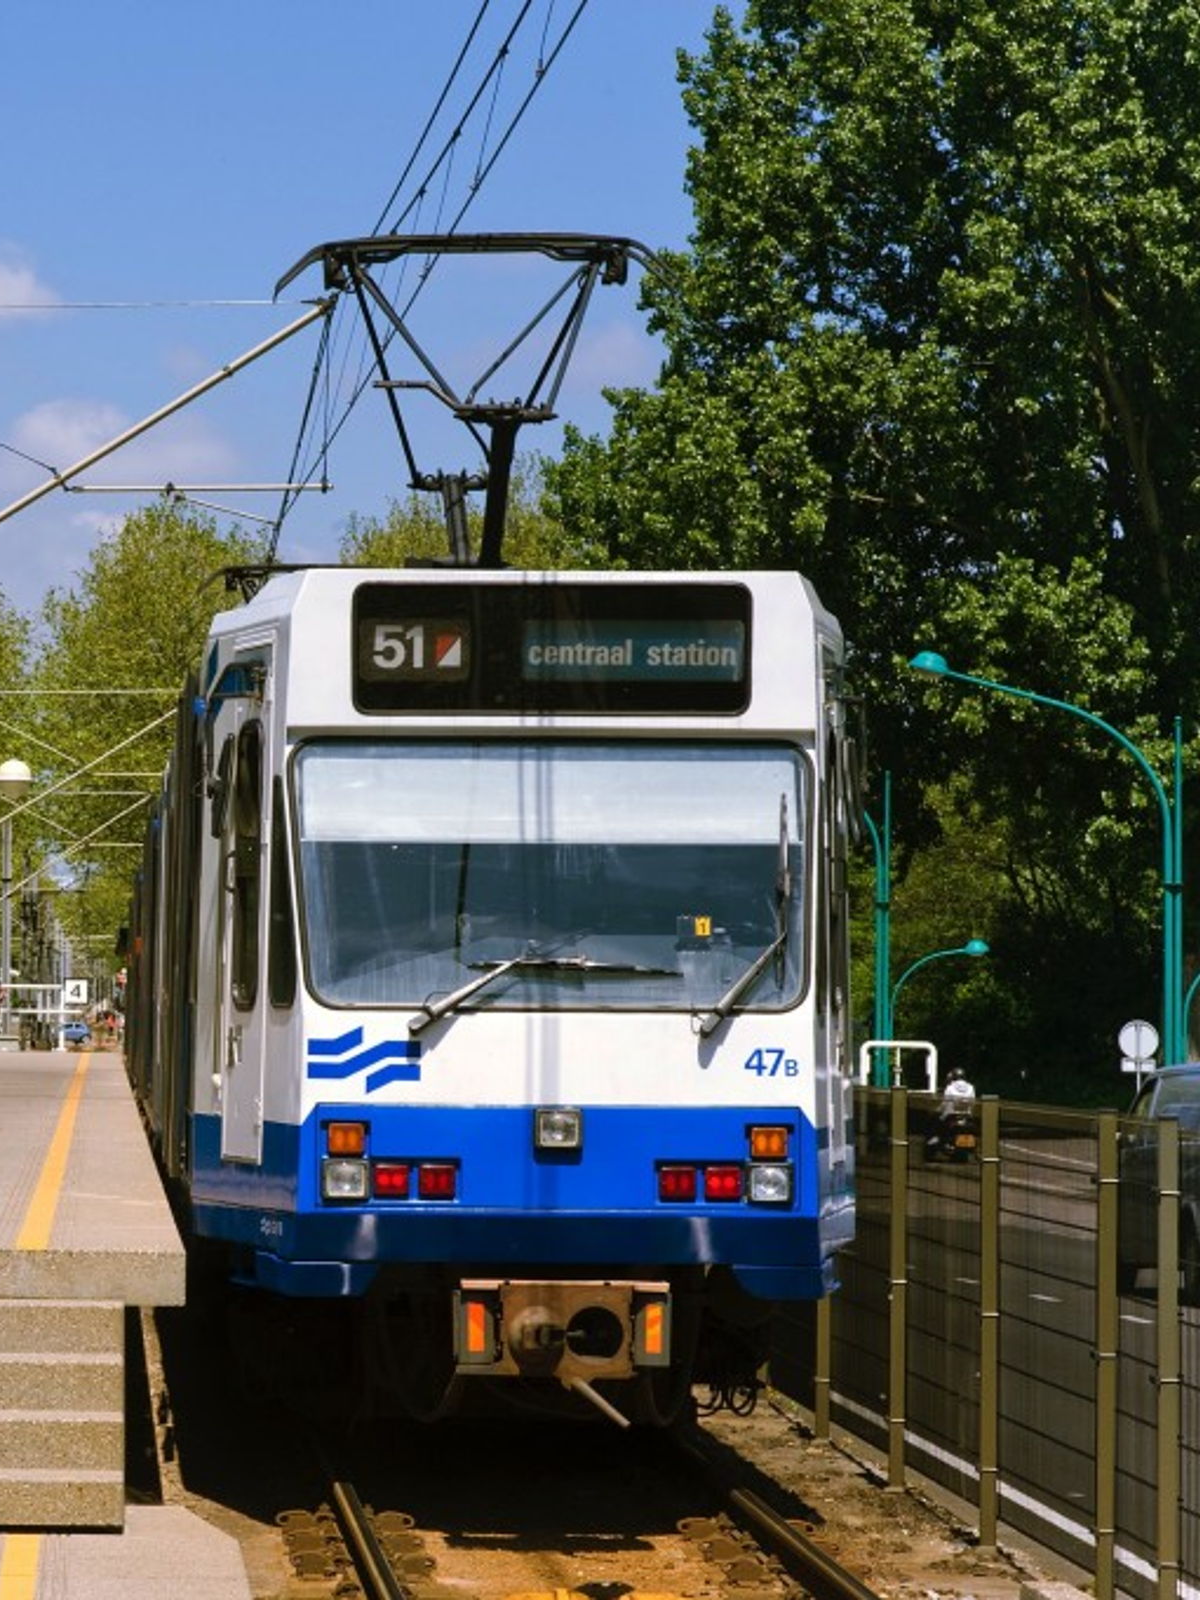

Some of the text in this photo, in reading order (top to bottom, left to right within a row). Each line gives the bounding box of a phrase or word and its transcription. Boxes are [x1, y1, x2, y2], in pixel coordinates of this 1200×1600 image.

[373, 625, 424, 669] 51
[528, 638, 737, 666] centraal station
[70, 984, 82, 999] 4
